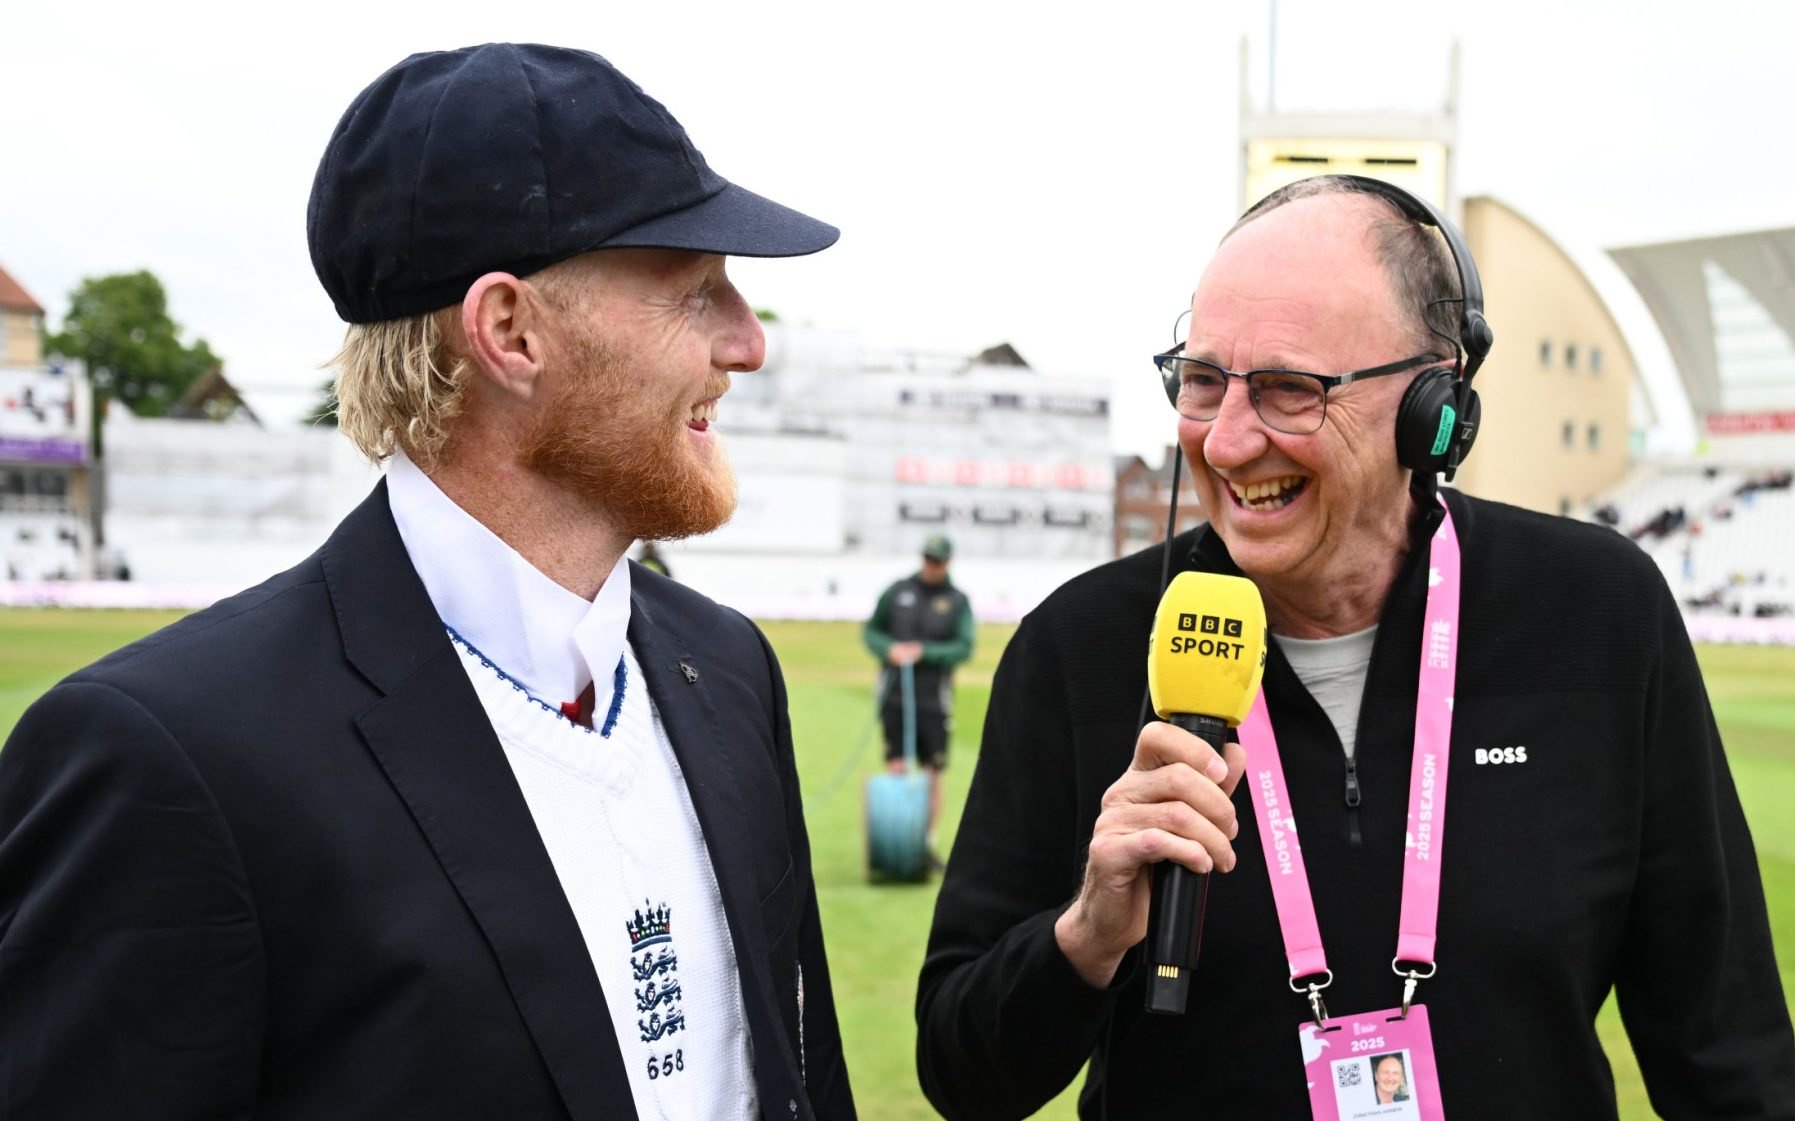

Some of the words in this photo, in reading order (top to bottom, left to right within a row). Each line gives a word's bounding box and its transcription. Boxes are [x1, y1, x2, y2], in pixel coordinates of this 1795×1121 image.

[1178, 613, 1242, 638] BBC
[1170, 636, 1244, 660] SPORT
[1475, 746, 1528, 765] BOSS
[1259, 769, 1278, 808] 2025
[1419, 753, 1436, 821] SEASON
[1268, 808, 1293, 875] SEASON
[1417, 822, 1431, 861] 2025
[1350, 1036, 1385, 1052] 2025
[647, 1048, 684, 1080] 658
